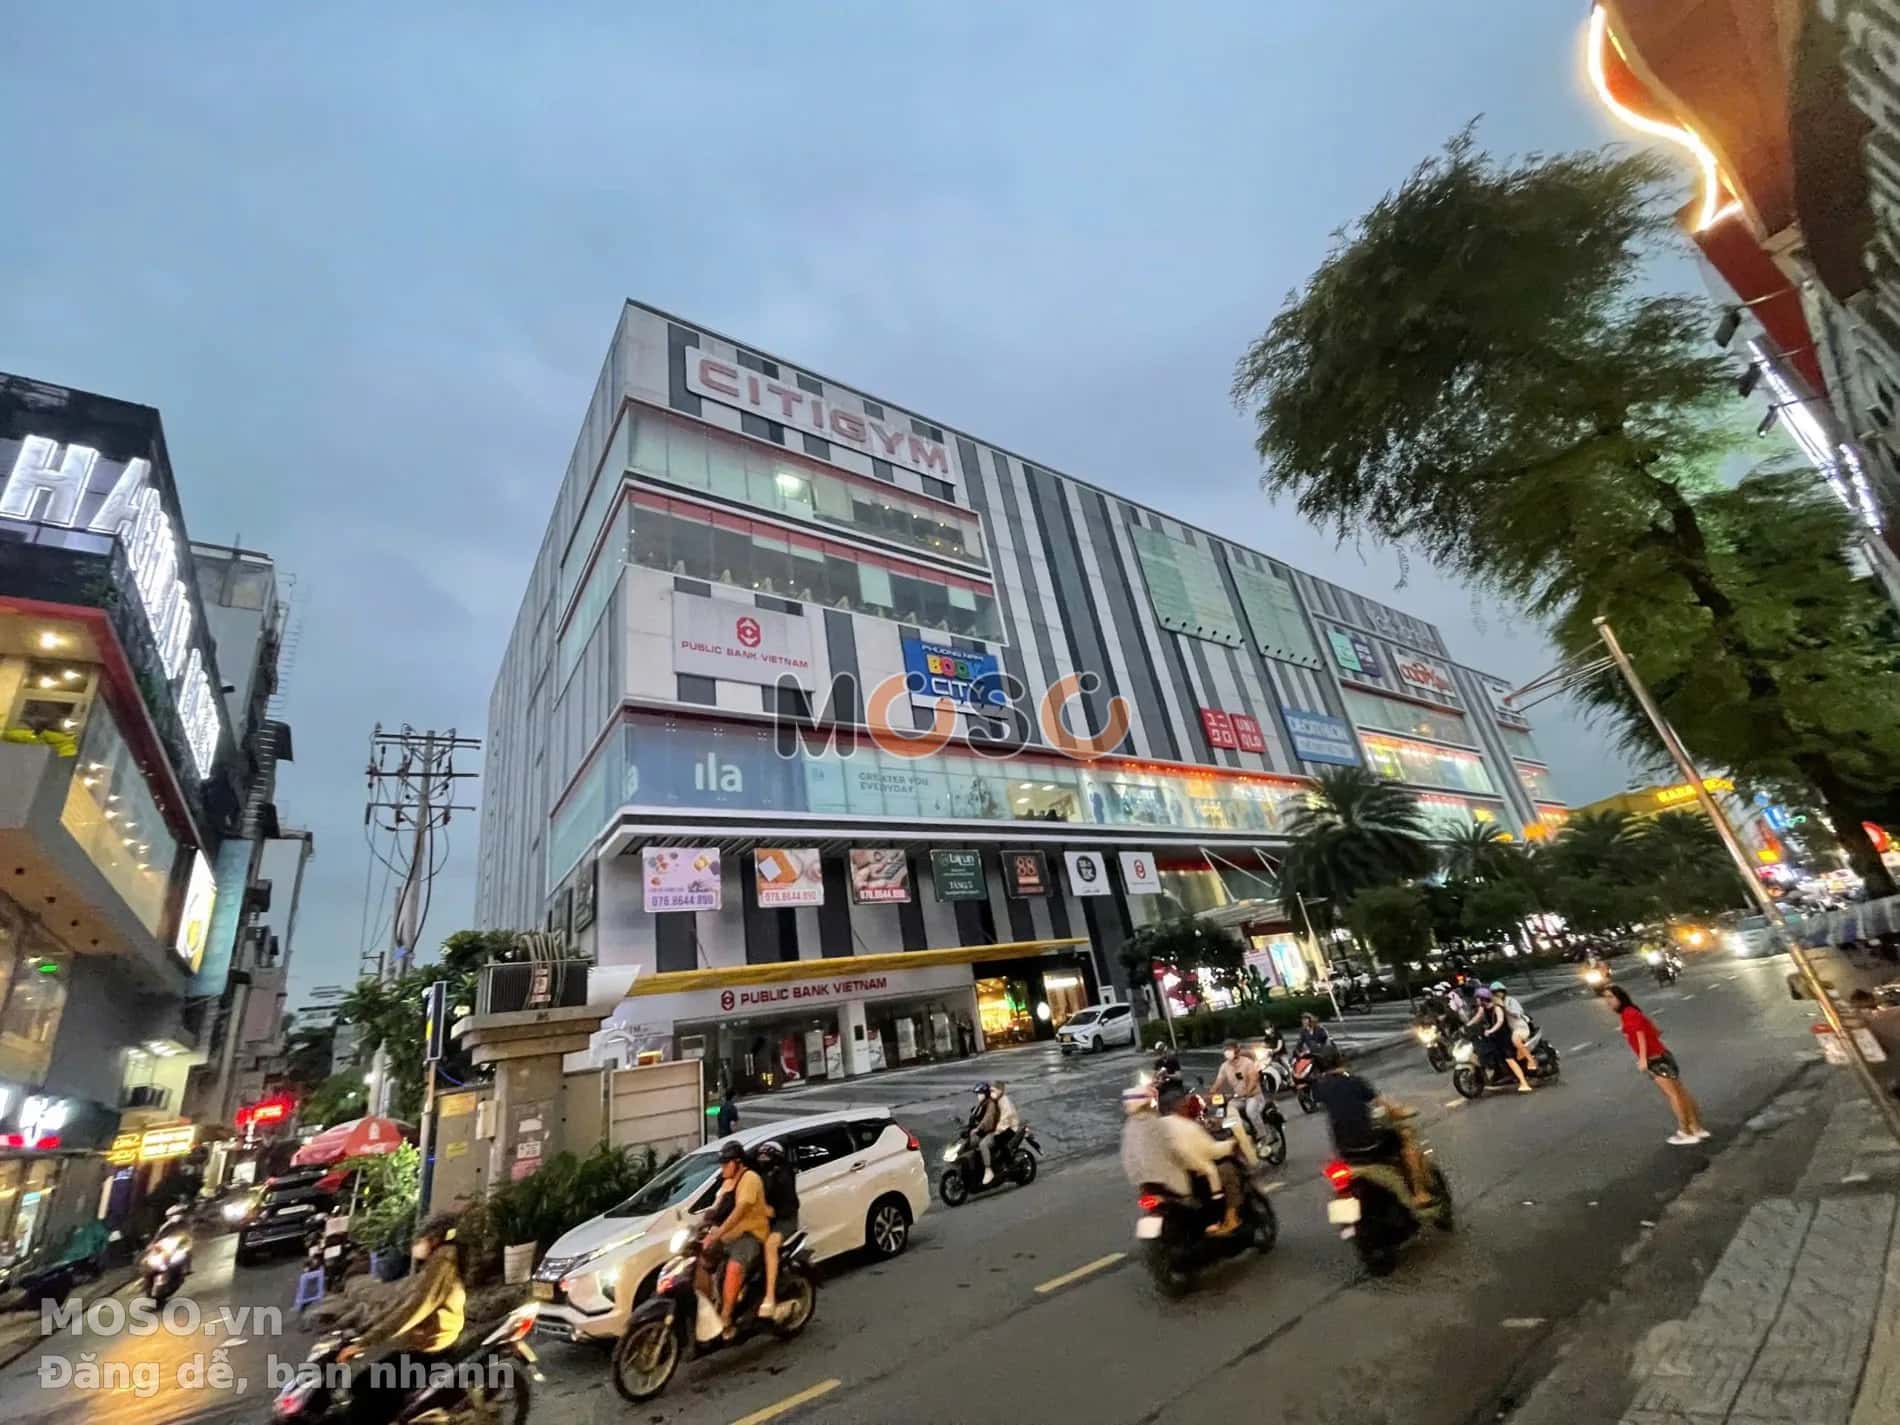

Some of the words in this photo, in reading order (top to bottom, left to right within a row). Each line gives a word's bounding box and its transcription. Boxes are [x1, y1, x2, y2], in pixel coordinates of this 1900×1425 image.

[700, 359, 948, 474] CITIGYM
[681, 640, 722, 655] PUBLIC
[726, 648, 757, 660] BANK
[761, 653, 809, 668] VIETNAM
[931, 677, 985, 700] CITY
[694, 751, 743, 793] ila
[740, 988, 790, 1005] PUBLIC
[793, 983, 830, 999] BANK
[833, 977, 887, 995] VIETNAM
